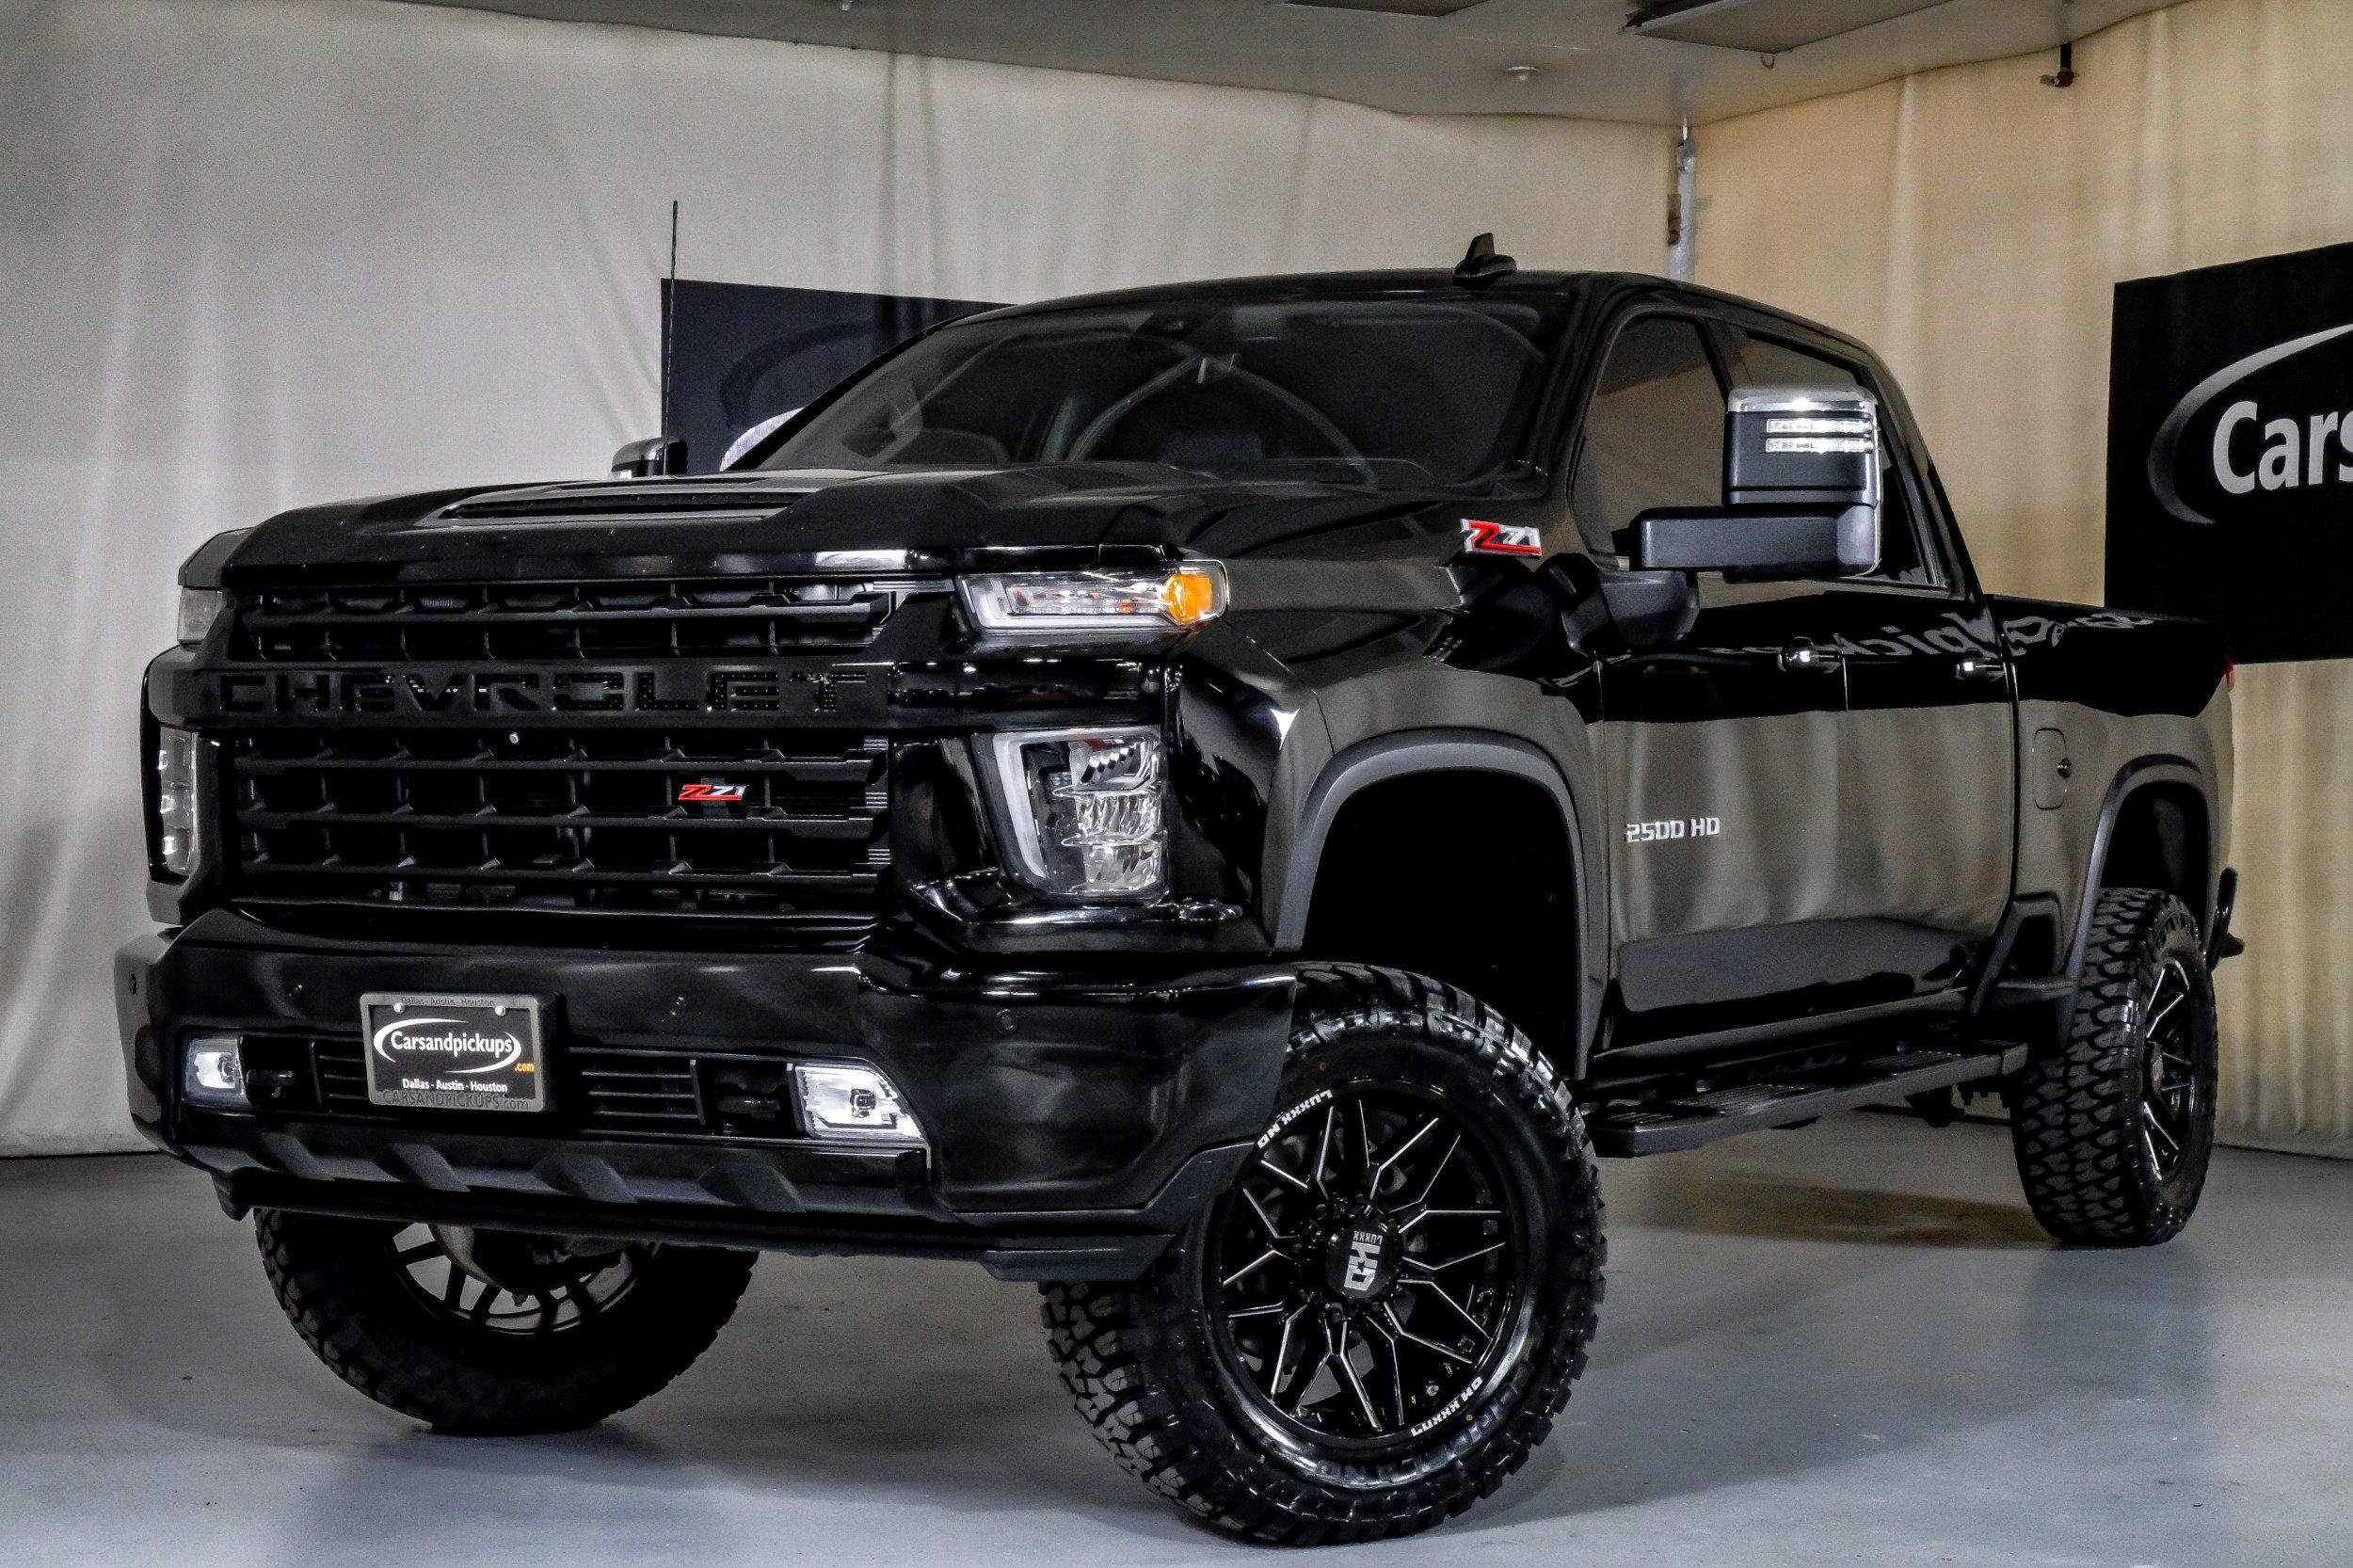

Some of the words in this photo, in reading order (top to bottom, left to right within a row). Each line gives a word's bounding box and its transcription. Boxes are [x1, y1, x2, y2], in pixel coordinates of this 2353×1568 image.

[1460, 519, 1543, 556] Z71
[219, 668, 867, 712] CHEVROLET
[678, 783, 748, 801] Z71
[1625, 820, 1685, 843] 2500
[1689, 817, 1721, 838] HD
[391, 1031, 514, 1058] Carsandpickups
[514, 1062, 536, 1073] .com
[402, 1078, 429, 1090] Dallas
[437, 1079, 464, 1091] Austin
[471, 1080, 508, 1093] Houston
[1281, 1089, 1333, 1126] LUXXX
[1410, 1400, 1461, 1436] LUXXX
